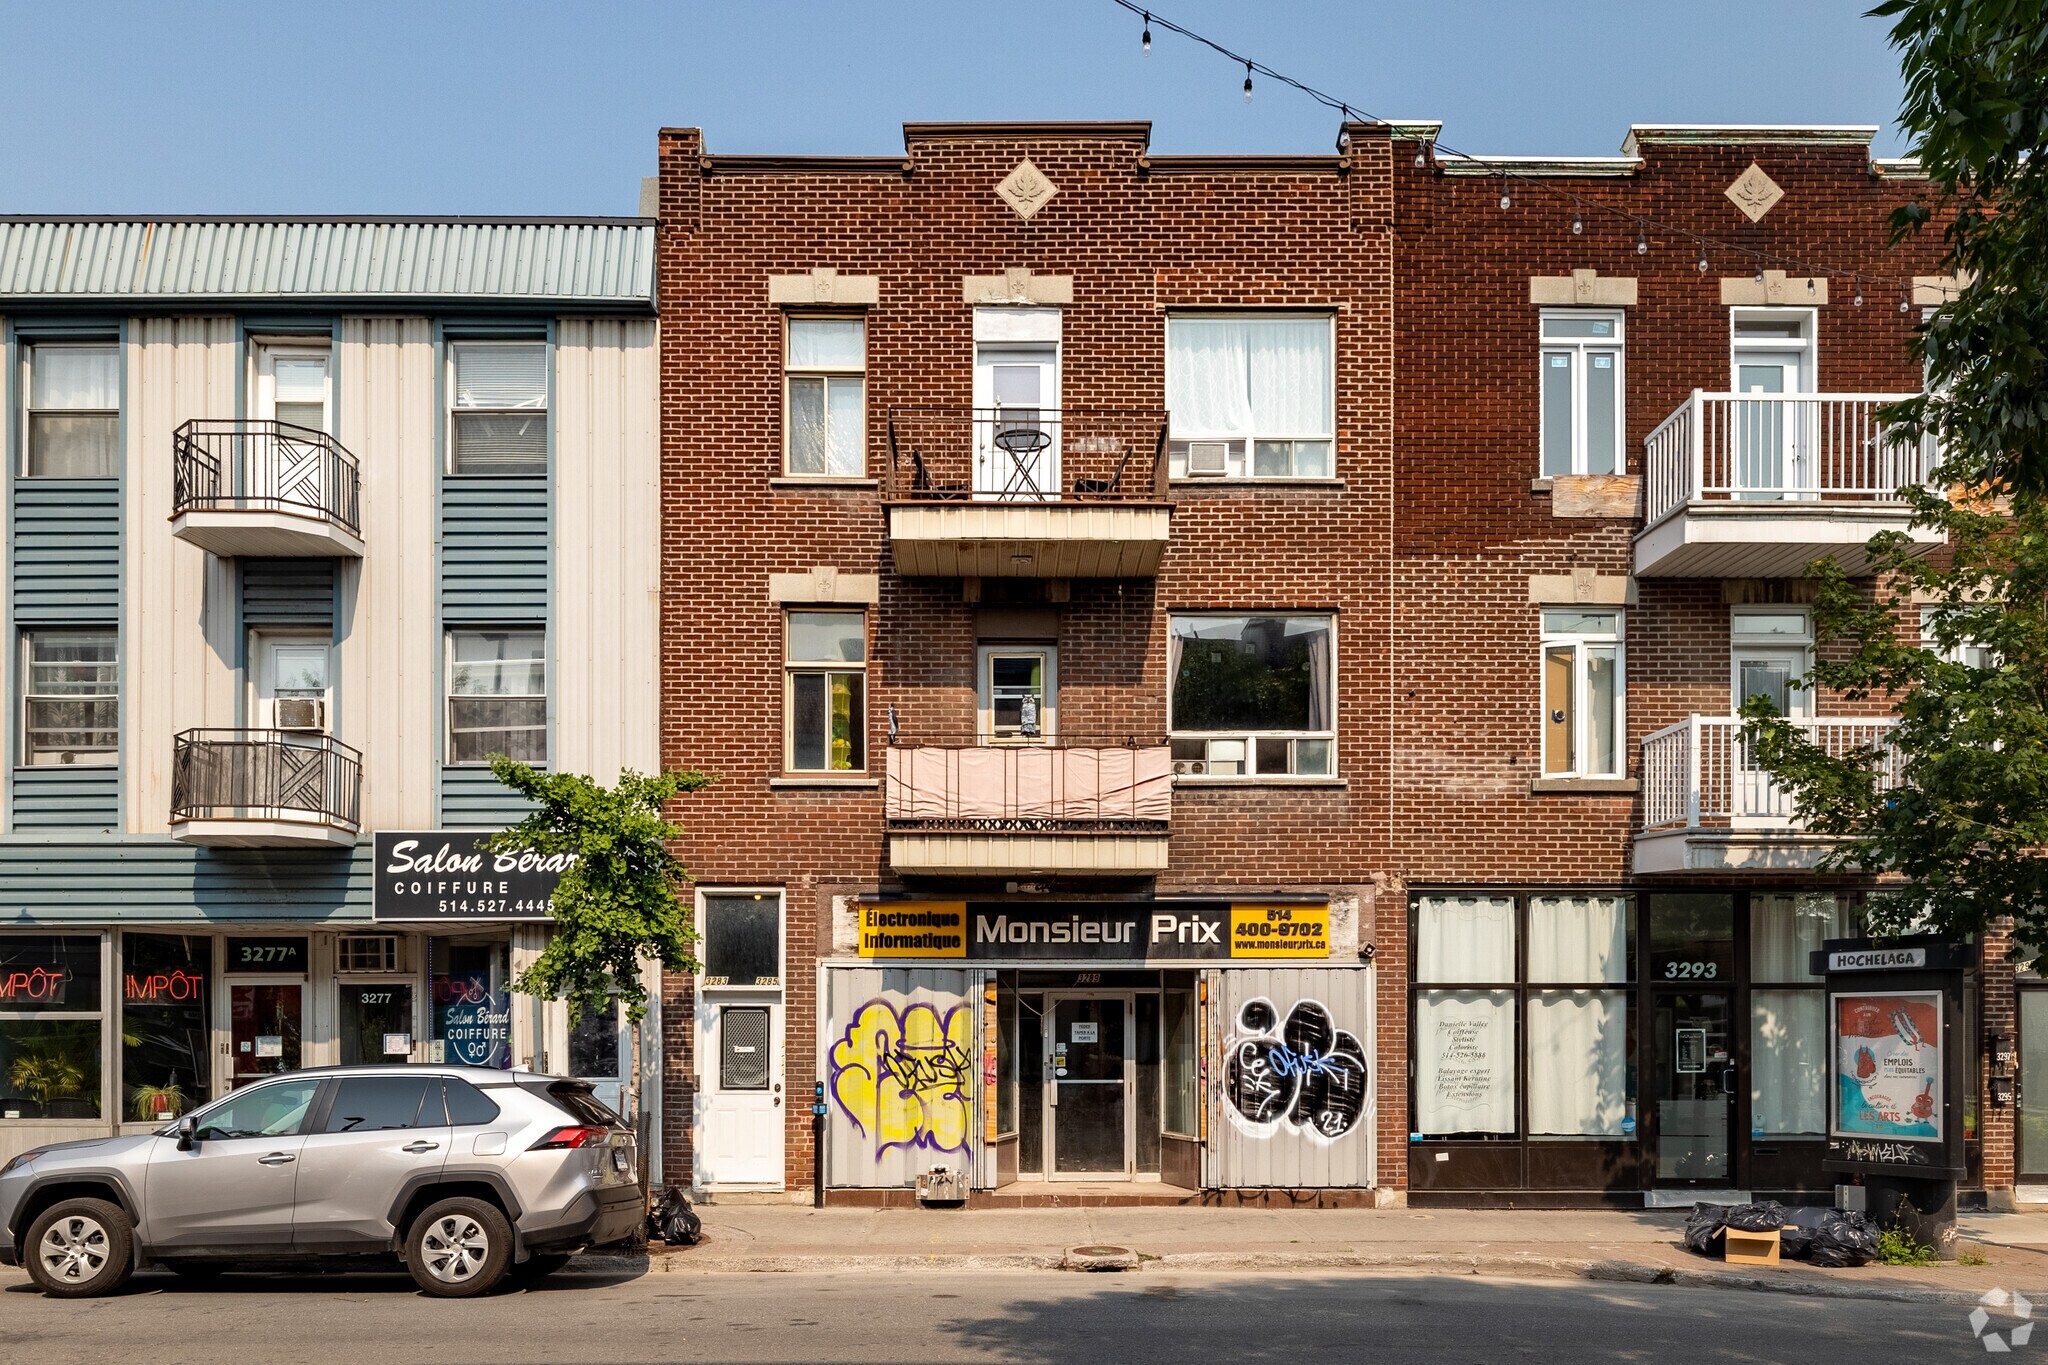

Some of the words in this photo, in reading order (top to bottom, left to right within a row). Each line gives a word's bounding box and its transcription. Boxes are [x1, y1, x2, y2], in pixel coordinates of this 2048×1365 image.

[386, 839, 483, 874] Salon
[493, 839, 580, 873] Bérar
[394, 881, 509, 894] COIFFURE
[438, 899, 555, 913] 514.527.4445
[866, 908, 960, 927] Électronique
[1266, 909, 1292, 921] 514
[976, 914, 1136, 943] Monsieur
[1151, 914, 1221, 944] Prix
[1235, 922, 1323, 936] 400-9702
[864, 932, 961, 949] Informatique
[1234, 939, 1326, 950] www.monsieurprix.ca
[1837, 952, 1915, 968] HOCHELAGA
[1665, 961, 1717, 979] 3293
[0, 967, 63, 998] MPÔT
[126, 970, 203, 1000] IMPÔT
[705, 977, 728, 986] 3283
[756, 977, 778, 986] 3285
[361, 993, 392, 1004] 3277
[446, 1007, 474, 1025] Salon
[477, 1006, 509, 1024] Bérard
[448, 1028, 507, 1039] COIFFURE
[1884, 1058, 1913, 1066] EMPLOIS
[1996, 1052, 2011, 1061] 3297
[1997, 1092, 2012, 1101] 3295
[1858, 1111, 1875, 1121] LES
[1877, 1111, 1901, 1122] ARTS
